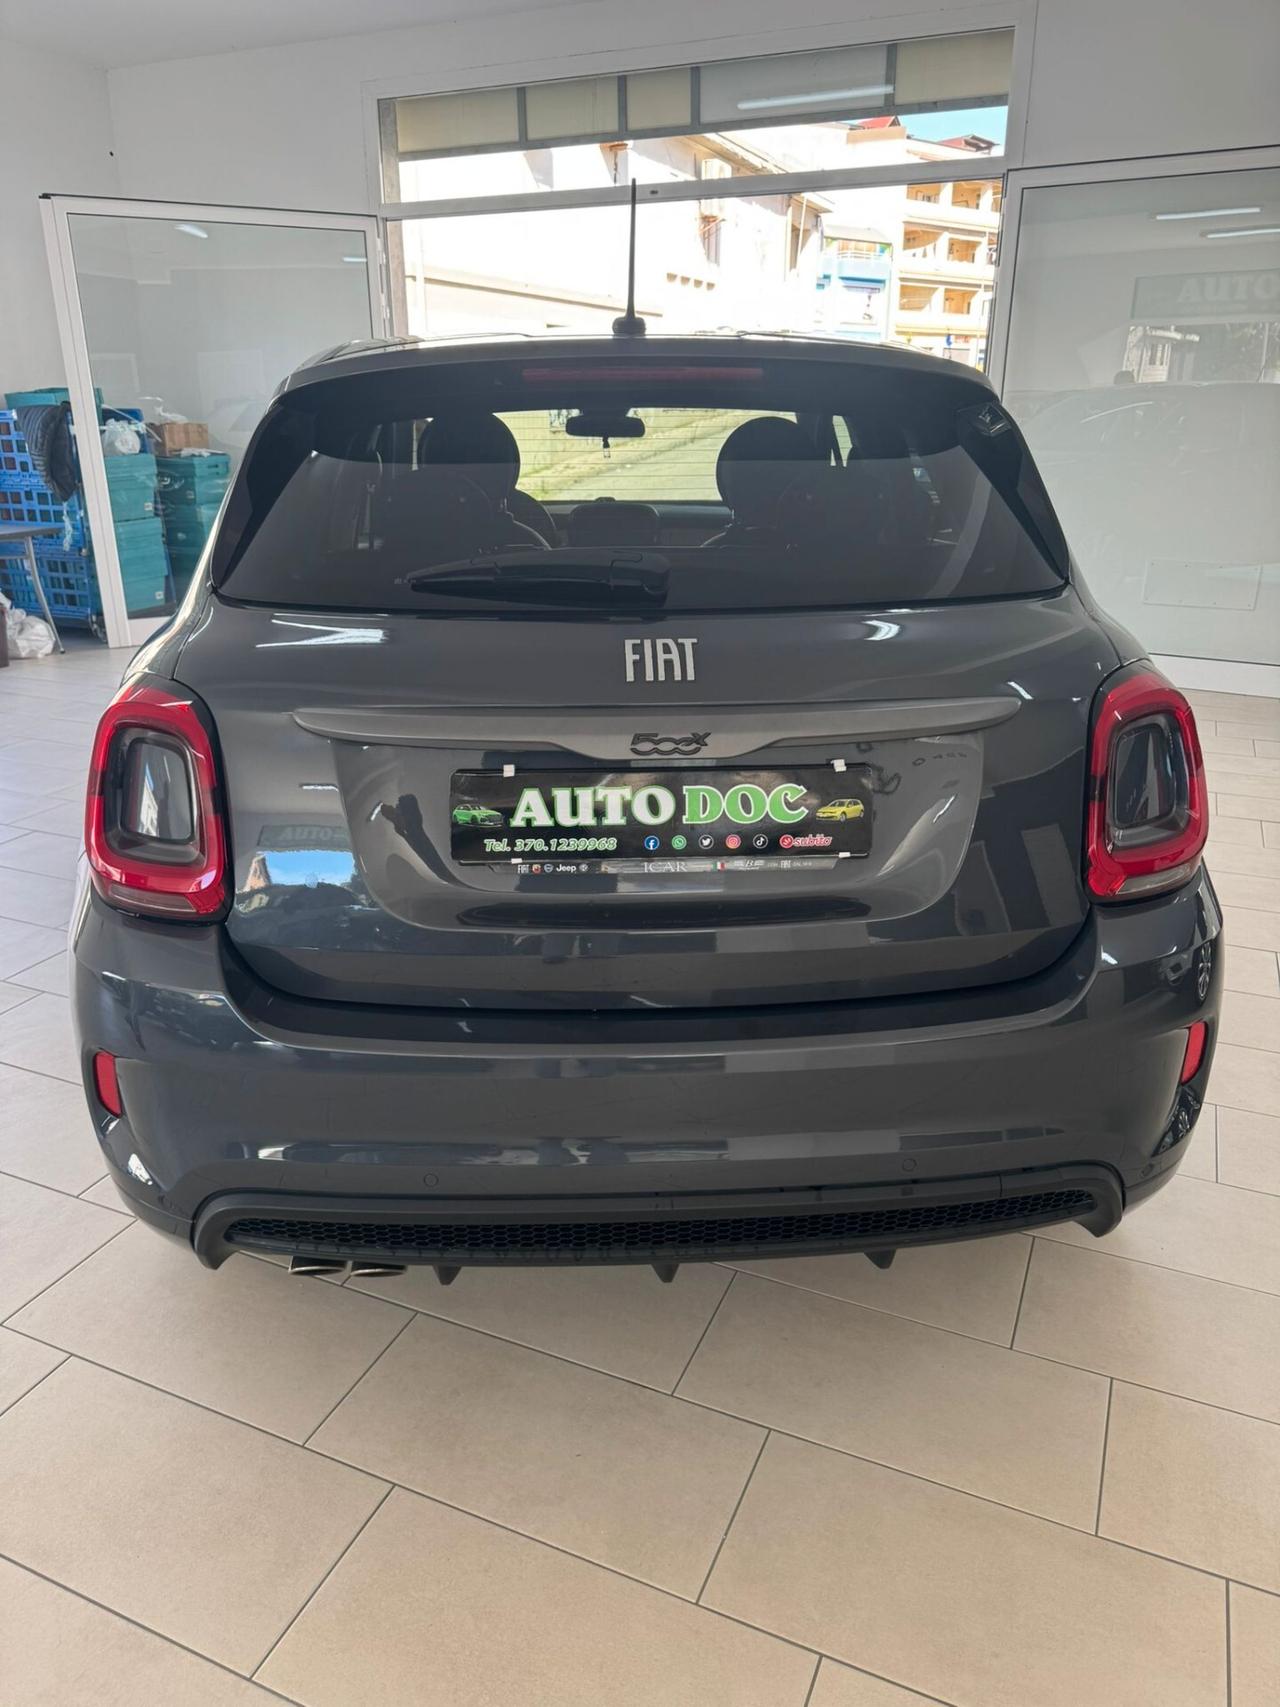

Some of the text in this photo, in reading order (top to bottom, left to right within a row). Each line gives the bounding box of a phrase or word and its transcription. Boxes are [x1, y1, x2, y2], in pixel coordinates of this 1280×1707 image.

[624, 638, 698, 682] FIAT
[509, 783, 809, 827] AUTO DOC
[484, 837, 617, 852] Tel. 370.1239968
[556, 864, 577, 873] Jeep
